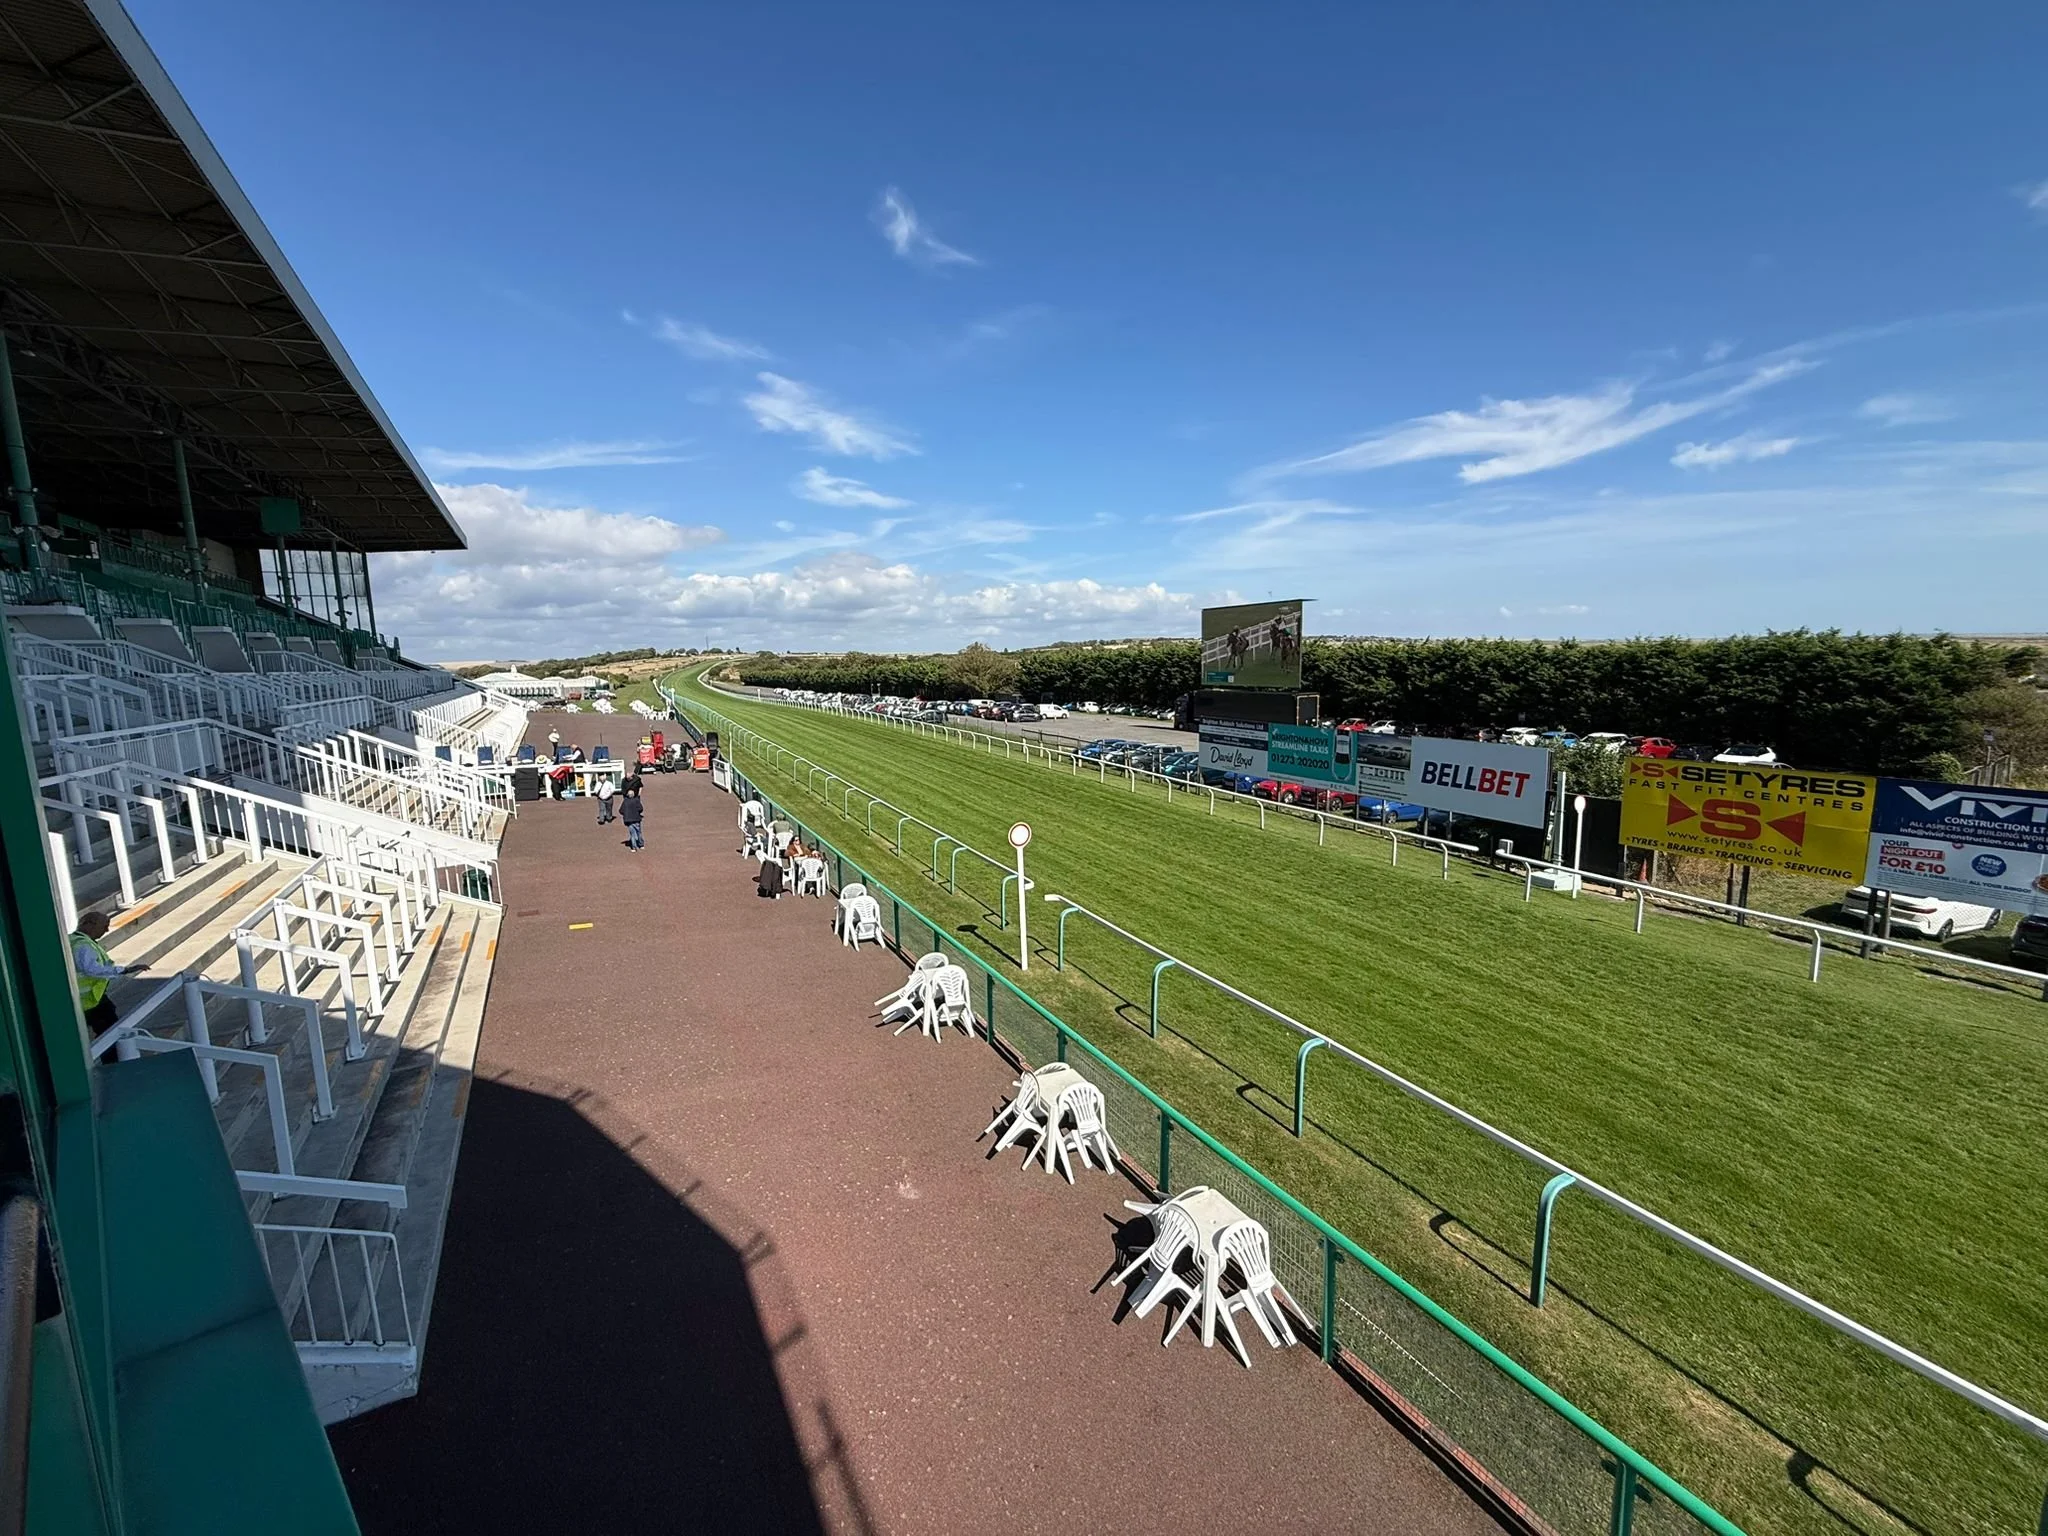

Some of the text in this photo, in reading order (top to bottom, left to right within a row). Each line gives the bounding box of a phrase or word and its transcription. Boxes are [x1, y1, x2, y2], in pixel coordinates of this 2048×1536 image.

[1210, 746, 1254, 769] David Lloyd
[1271, 740, 1309, 752] STREAMLINE
[1310, 744, 1329, 755] TAXIS
[1271, 753, 1330, 769] 01273 202020
[1420, 760, 1531, 798] BELLBET
[1680, 765, 1866, 798] SETYRES
[1629, 778, 1864, 812] FAST FIT CENTRES
[1899, 785, 2048, 824] VIVI
[1909, 820, 1924, 828] ALL
[1925, 823, 1961, 832] ASPECTS
[1977, 829, 2020, 840] BUILDING
[1944, 816, 2048, 835] CONSTRUCTION LT
[1666, 831, 1803, 858] www.setyres.co.uk
[1881, 839, 1910, 847] YOUR
[1883, 846, 1939, 858] NIGHT OUT
[1630, 836, 1853, 880] TYRES BRAKES TRACKING SERVICING
[1879, 855, 1946, 875] FOR £10
[1979, 856, 2002, 866] NEW
